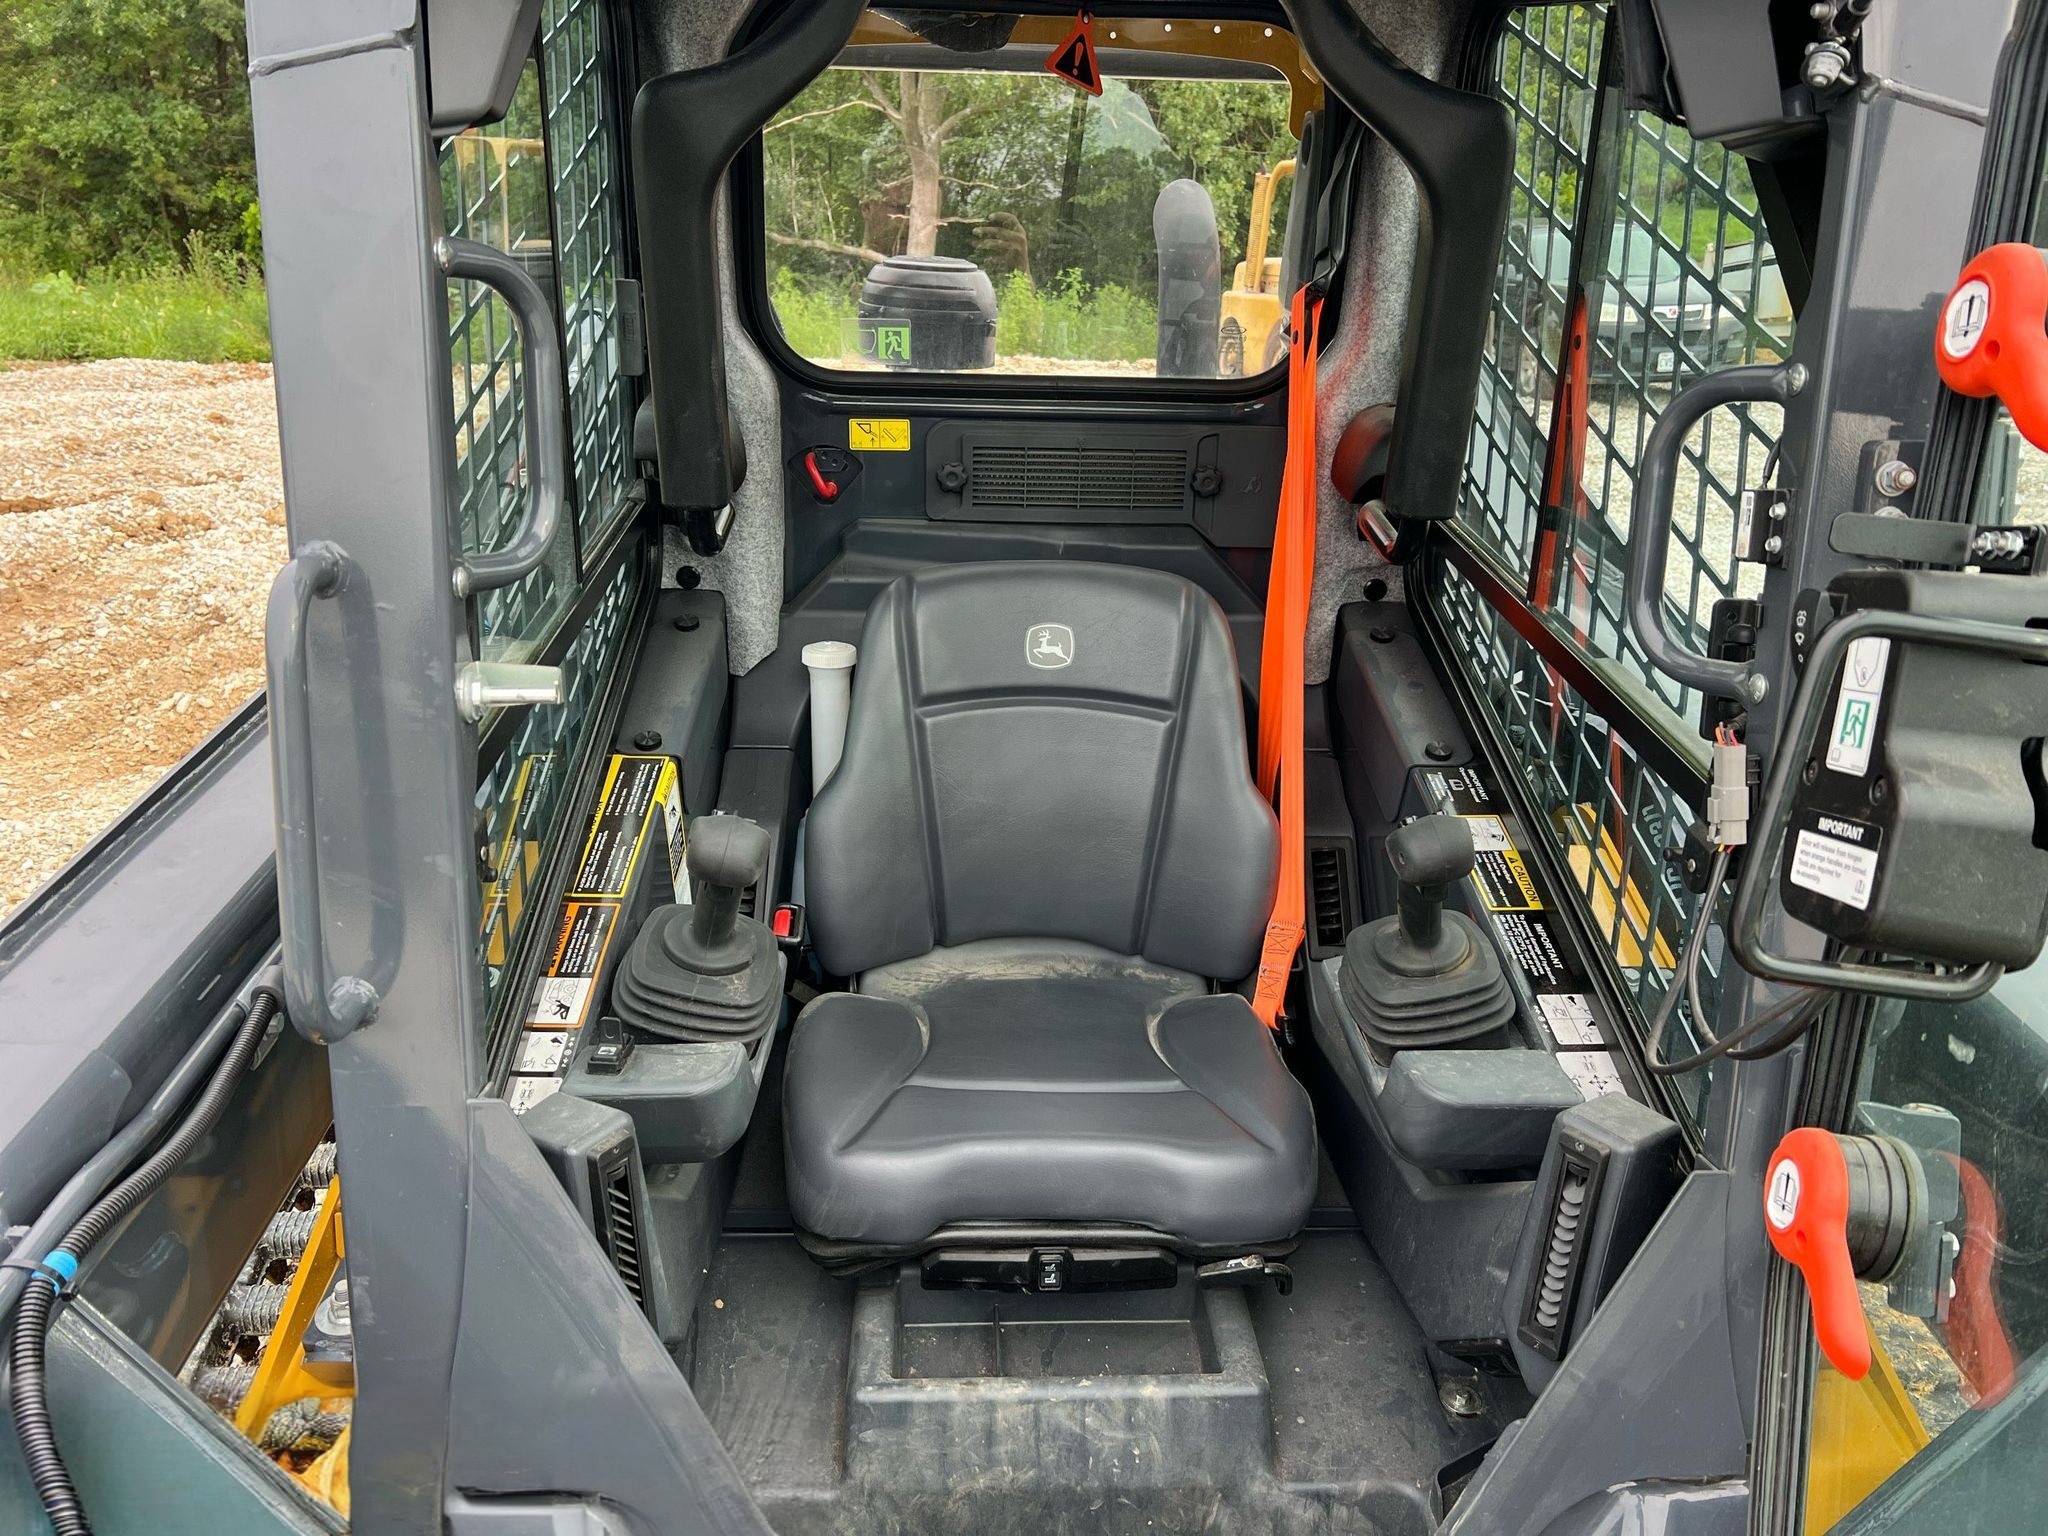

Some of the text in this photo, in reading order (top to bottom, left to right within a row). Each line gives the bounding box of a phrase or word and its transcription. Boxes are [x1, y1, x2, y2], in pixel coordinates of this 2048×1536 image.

[1468, 769, 1488, 800] IMPORTANT
[1817, 816, 1864, 841] IMPORTANT
[1513, 865, 1539, 901] CAUTION
[1534, 924, 1563, 968] IMPORTANT
